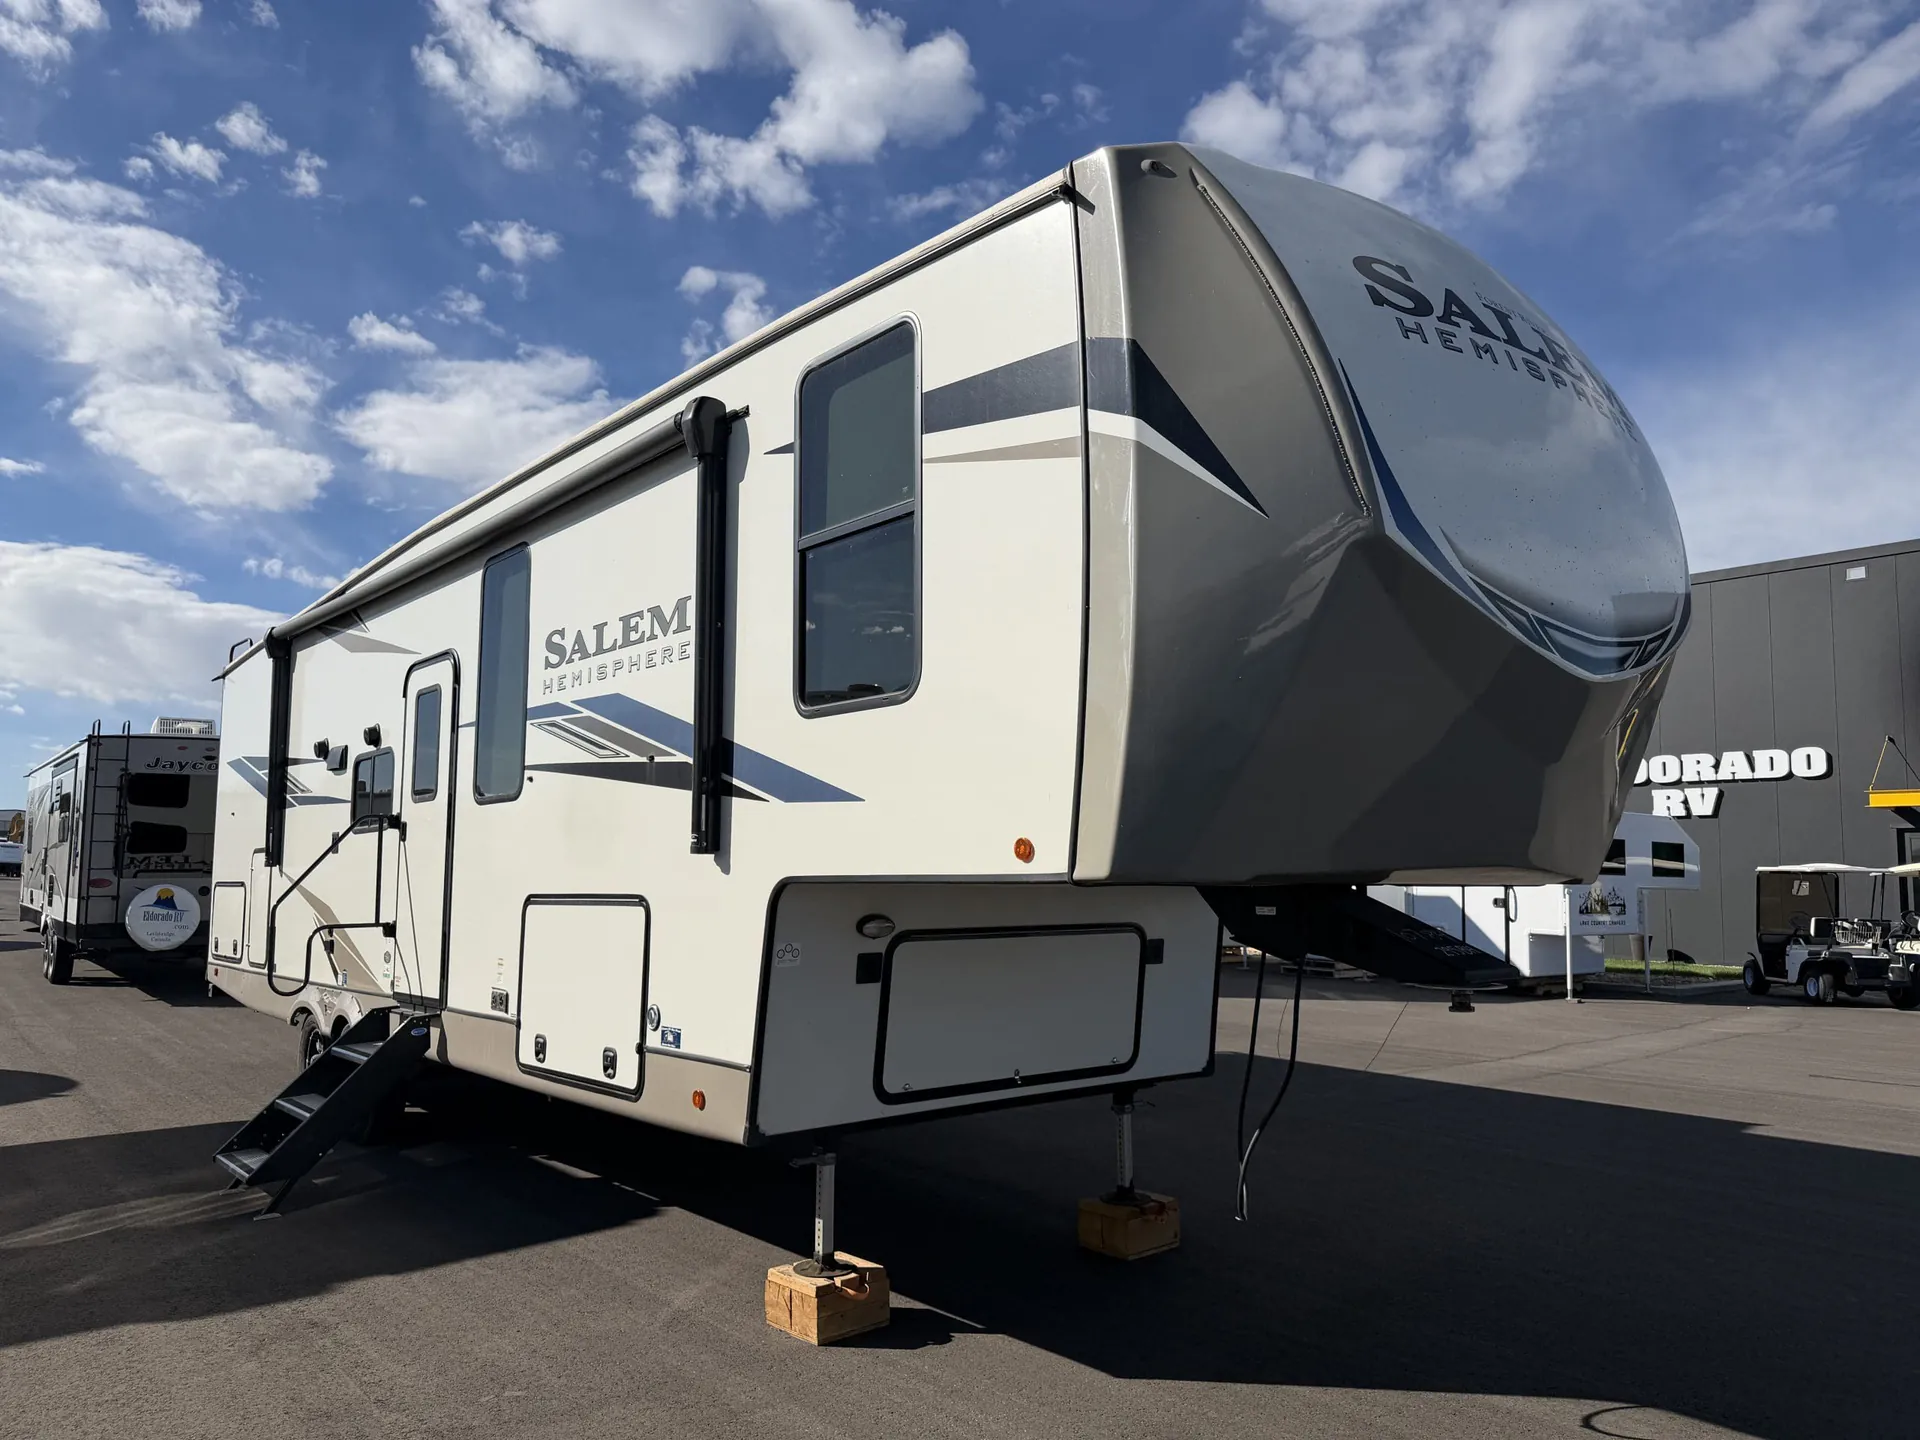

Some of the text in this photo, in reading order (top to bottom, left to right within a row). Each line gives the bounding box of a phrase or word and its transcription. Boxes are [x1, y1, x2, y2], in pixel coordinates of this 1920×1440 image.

[544, 595, 692, 670] SALEM
[542, 640, 691, 695] HEMISPHERE
[145, 757, 219, 772] Jayco
[1652, 787, 1718, 816] RV
[143, 910, 185, 922] Eldorado RV
